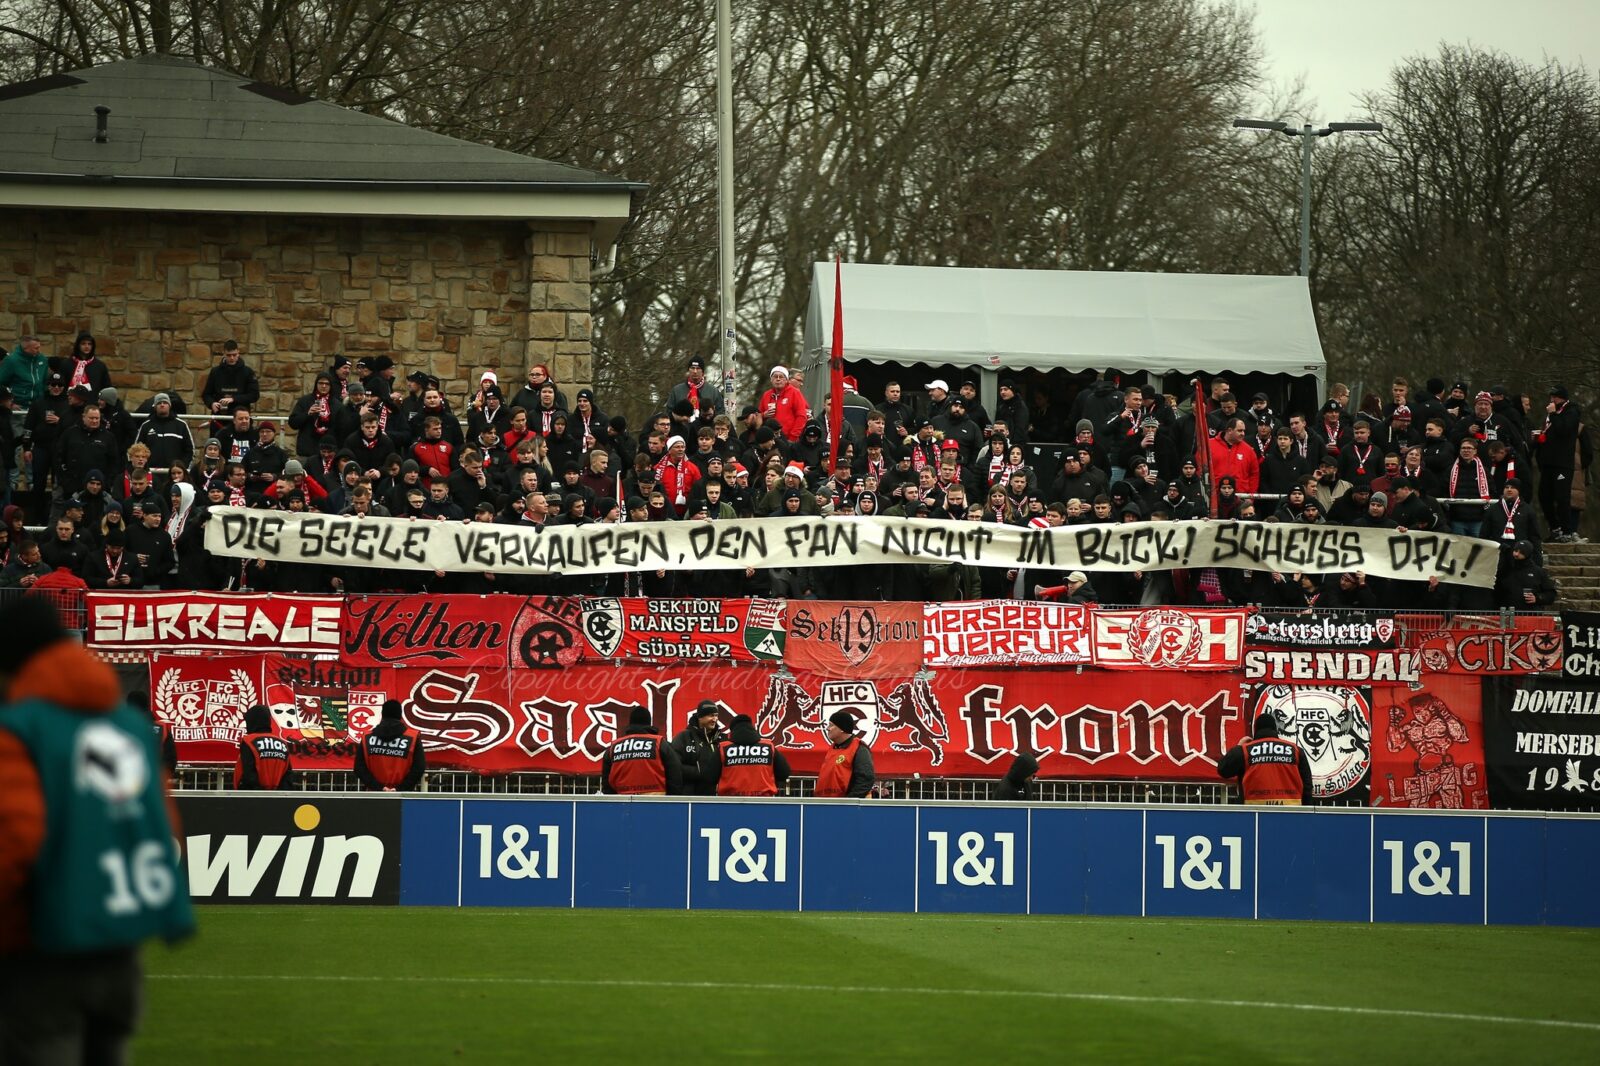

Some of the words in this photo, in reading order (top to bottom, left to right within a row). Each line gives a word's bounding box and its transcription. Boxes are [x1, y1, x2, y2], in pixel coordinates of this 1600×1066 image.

[222, 515, 282, 553] DIE
[299, 518, 429, 563] SEELE
[688, 524, 767, 560] DEN
[785, 522, 858, 558] FAN
[882, 526, 992, 560] NICHT
[1016, 530, 1055, 565] IM
[1075, 526, 1196, 566] BLICK!
[1211, 521, 1365, 569] SCHEISS
[1387, 534, 1482, 578] DFL!
[648, 600, 720, 613] SEKTION
[94, 603, 341, 645] SURREALE
[630, 615, 739, 632] MANSFELD
[924, 606, 1090, 633] MERSEBUR
[1160, 615, 1185, 626] HFC
[345, 598, 505, 662] Köthen
[638, 638, 731, 658] SÜDHARZ
[1457, 634, 1533, 671] CTK
[1245, 650, 1420, 681] STENDAL
[174, 681, 200, 693] HFC
[216, 682, 234, 694] FC
[829, 685, 869, 702] HFC
[208, 692, 239, 705] RWE
[349, 693, 372, 705] HFC
[401, 669, 738, 763] Saal
[960, 684, 1238, 766] front
[1300, 711, 1325, 720] HFC
[613, 738, 653, 754] atlas
[726, 745, 770, 758] atlas
[1250, 741, 1293, 756] atlas
[613, 752, 633, 761] SAFETY
[633, 751, 651, 759] SHOES
[727, 757, 749, 765] SAFETY
[1251, 756, 1273, 764] SAFETY
[1273, 755, 1293, 763] SHOES
[172, 804, 384, 898] win
[472, 824, 559, 879] 1&1
[700, 828, 787, 882] 1&1
[928, 831, 1014, 886] 1&1
[1155, 835, 1242, 891] 1&1
[1383, 840, 1471, 896] 1&1
[100, 840, 176, 917] 16
